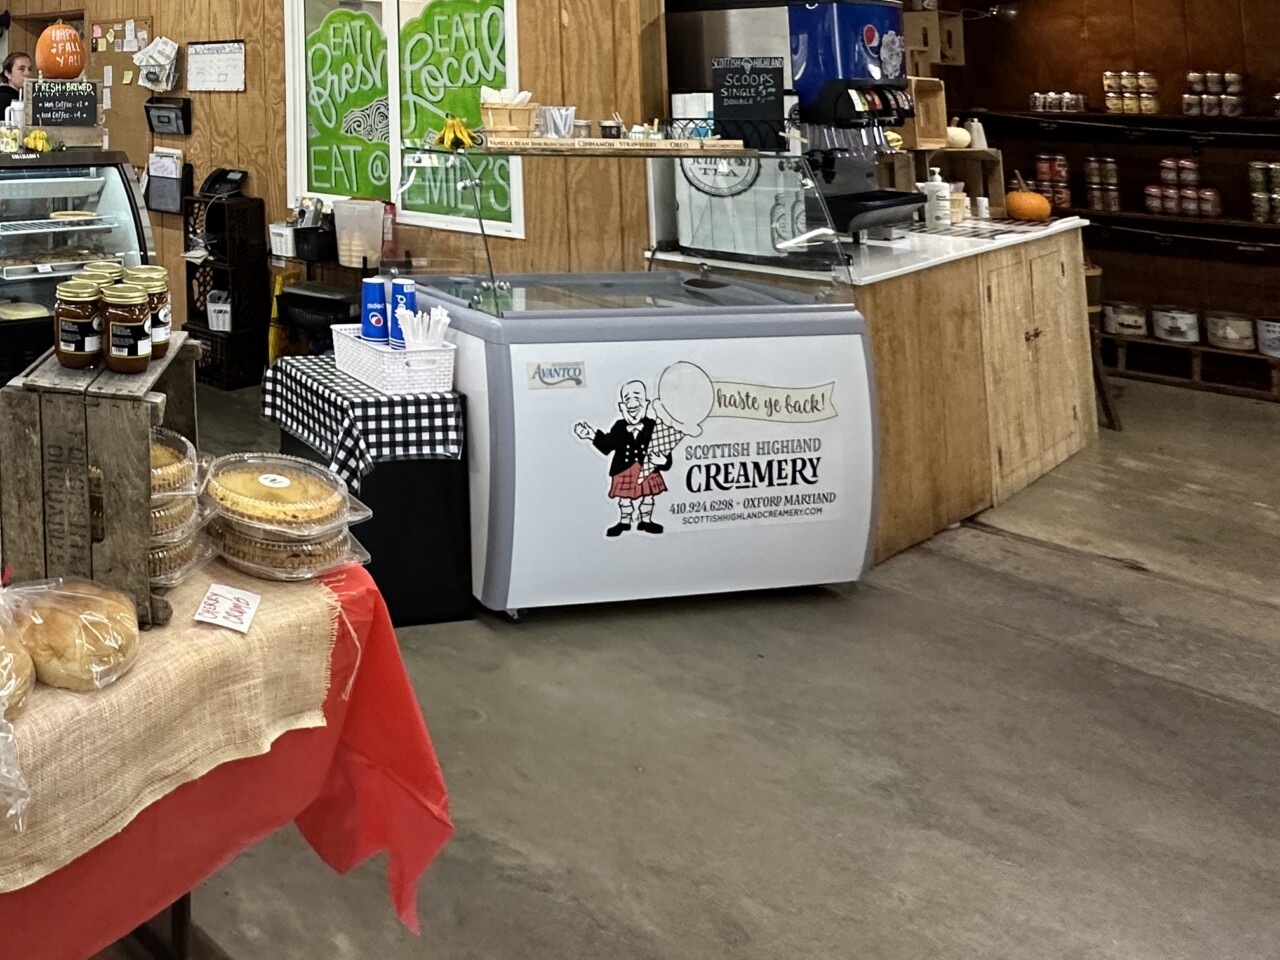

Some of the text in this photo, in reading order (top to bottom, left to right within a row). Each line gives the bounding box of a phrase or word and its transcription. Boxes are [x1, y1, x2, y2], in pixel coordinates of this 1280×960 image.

[329, 21, 365, 56] EAT
[434, 12, 481, 52] EAT
[711, 57, 784, 69] SCOTTISH HIGHLAND
[724, 73, 774, 86] SCOOPS
[35, 82, 93, 93] FRESH BREWED
[720, 87, 757, 97] SINGLE
[55, 100, 72, 109] Coffee
[723, 97, 753, 106] DOUBLE
[52, 109, 69, 118] Coffee
[670, 141, 689, 149] OREO
[311, 145, 389, 192] EAT @
[716, 388, 825, 417] haste ye back!
[685, 438, 822, 460] SCOTTISH HIGHLAND
[685, 457, 822, 493] CREAMERY
[670, 498, 734, 515] 410.924.6298
[743, 495, 782, 509] OXFORD
[783, 492, 837, 507] MARYLAND
[682, 507, 823, 525] SCOTTISHHIGHLANDCREAMERY.COM
